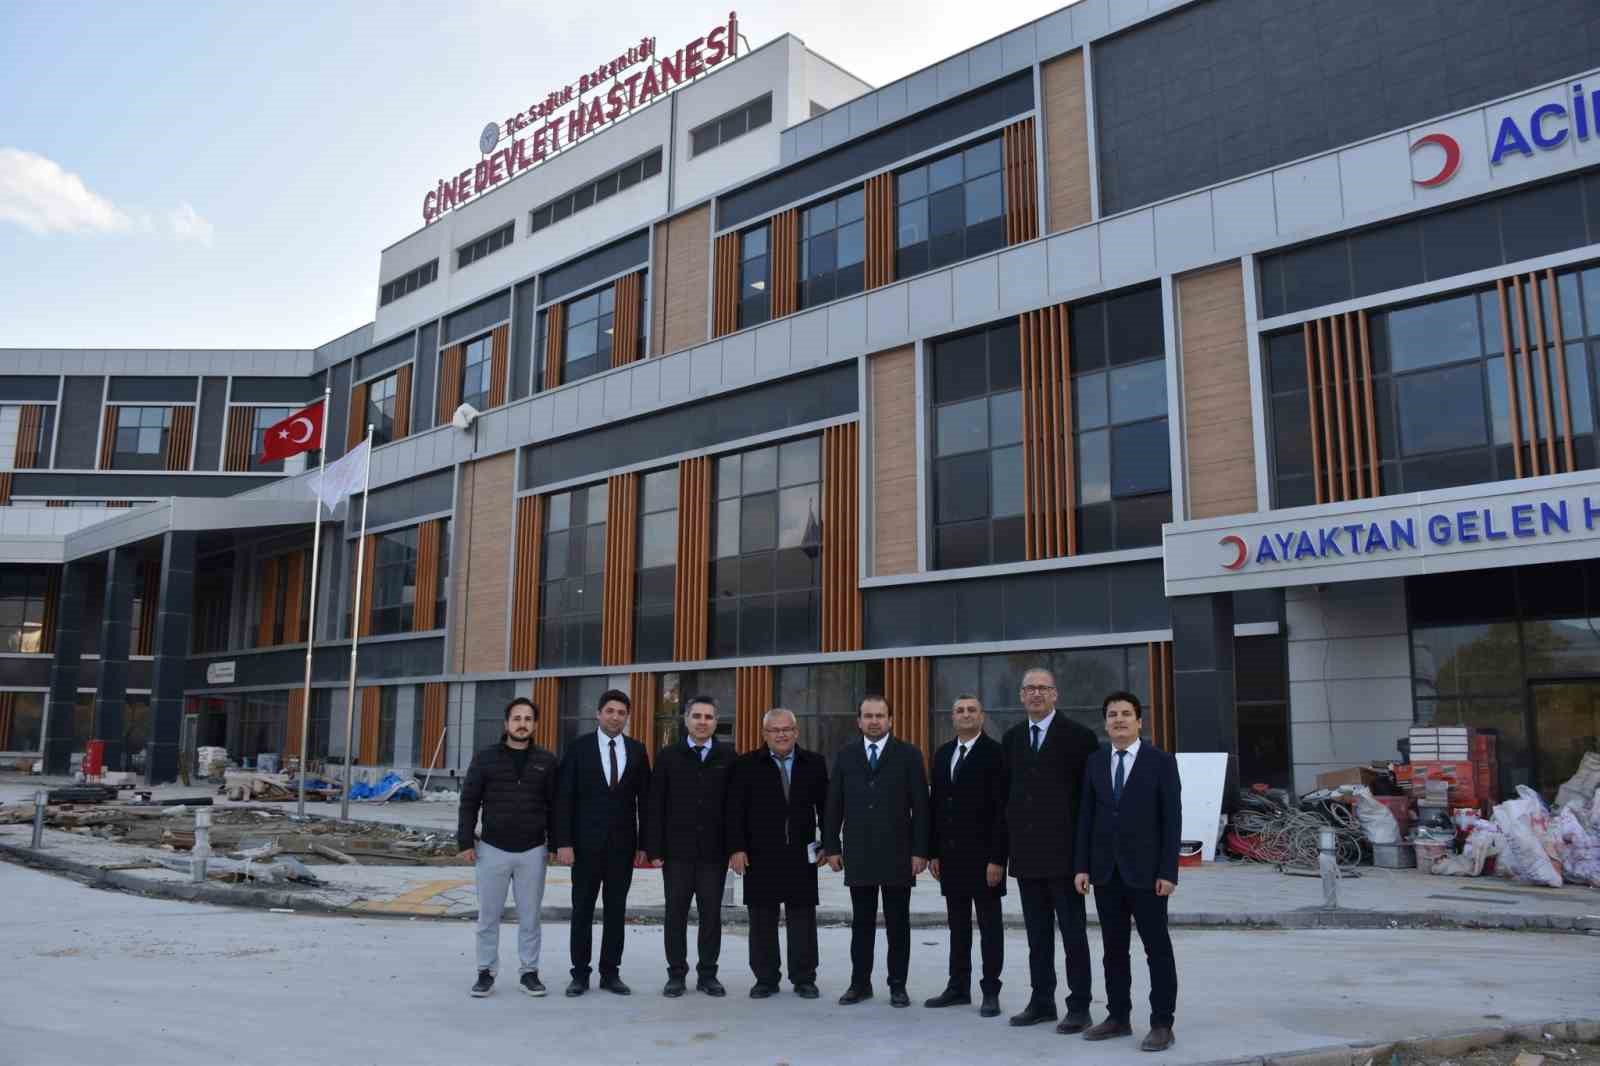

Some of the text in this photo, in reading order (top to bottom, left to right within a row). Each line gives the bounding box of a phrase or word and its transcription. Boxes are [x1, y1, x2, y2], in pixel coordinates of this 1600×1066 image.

[579, 36, 656, 92] Bakanlığı
[474, 115, 565, 194] DEVLET
[568, 11, 738, 143] HASTANESİ
[1255, 518, 1416, 564] AYAKTAN
[1427, 500, 1570, 546] GELEN
